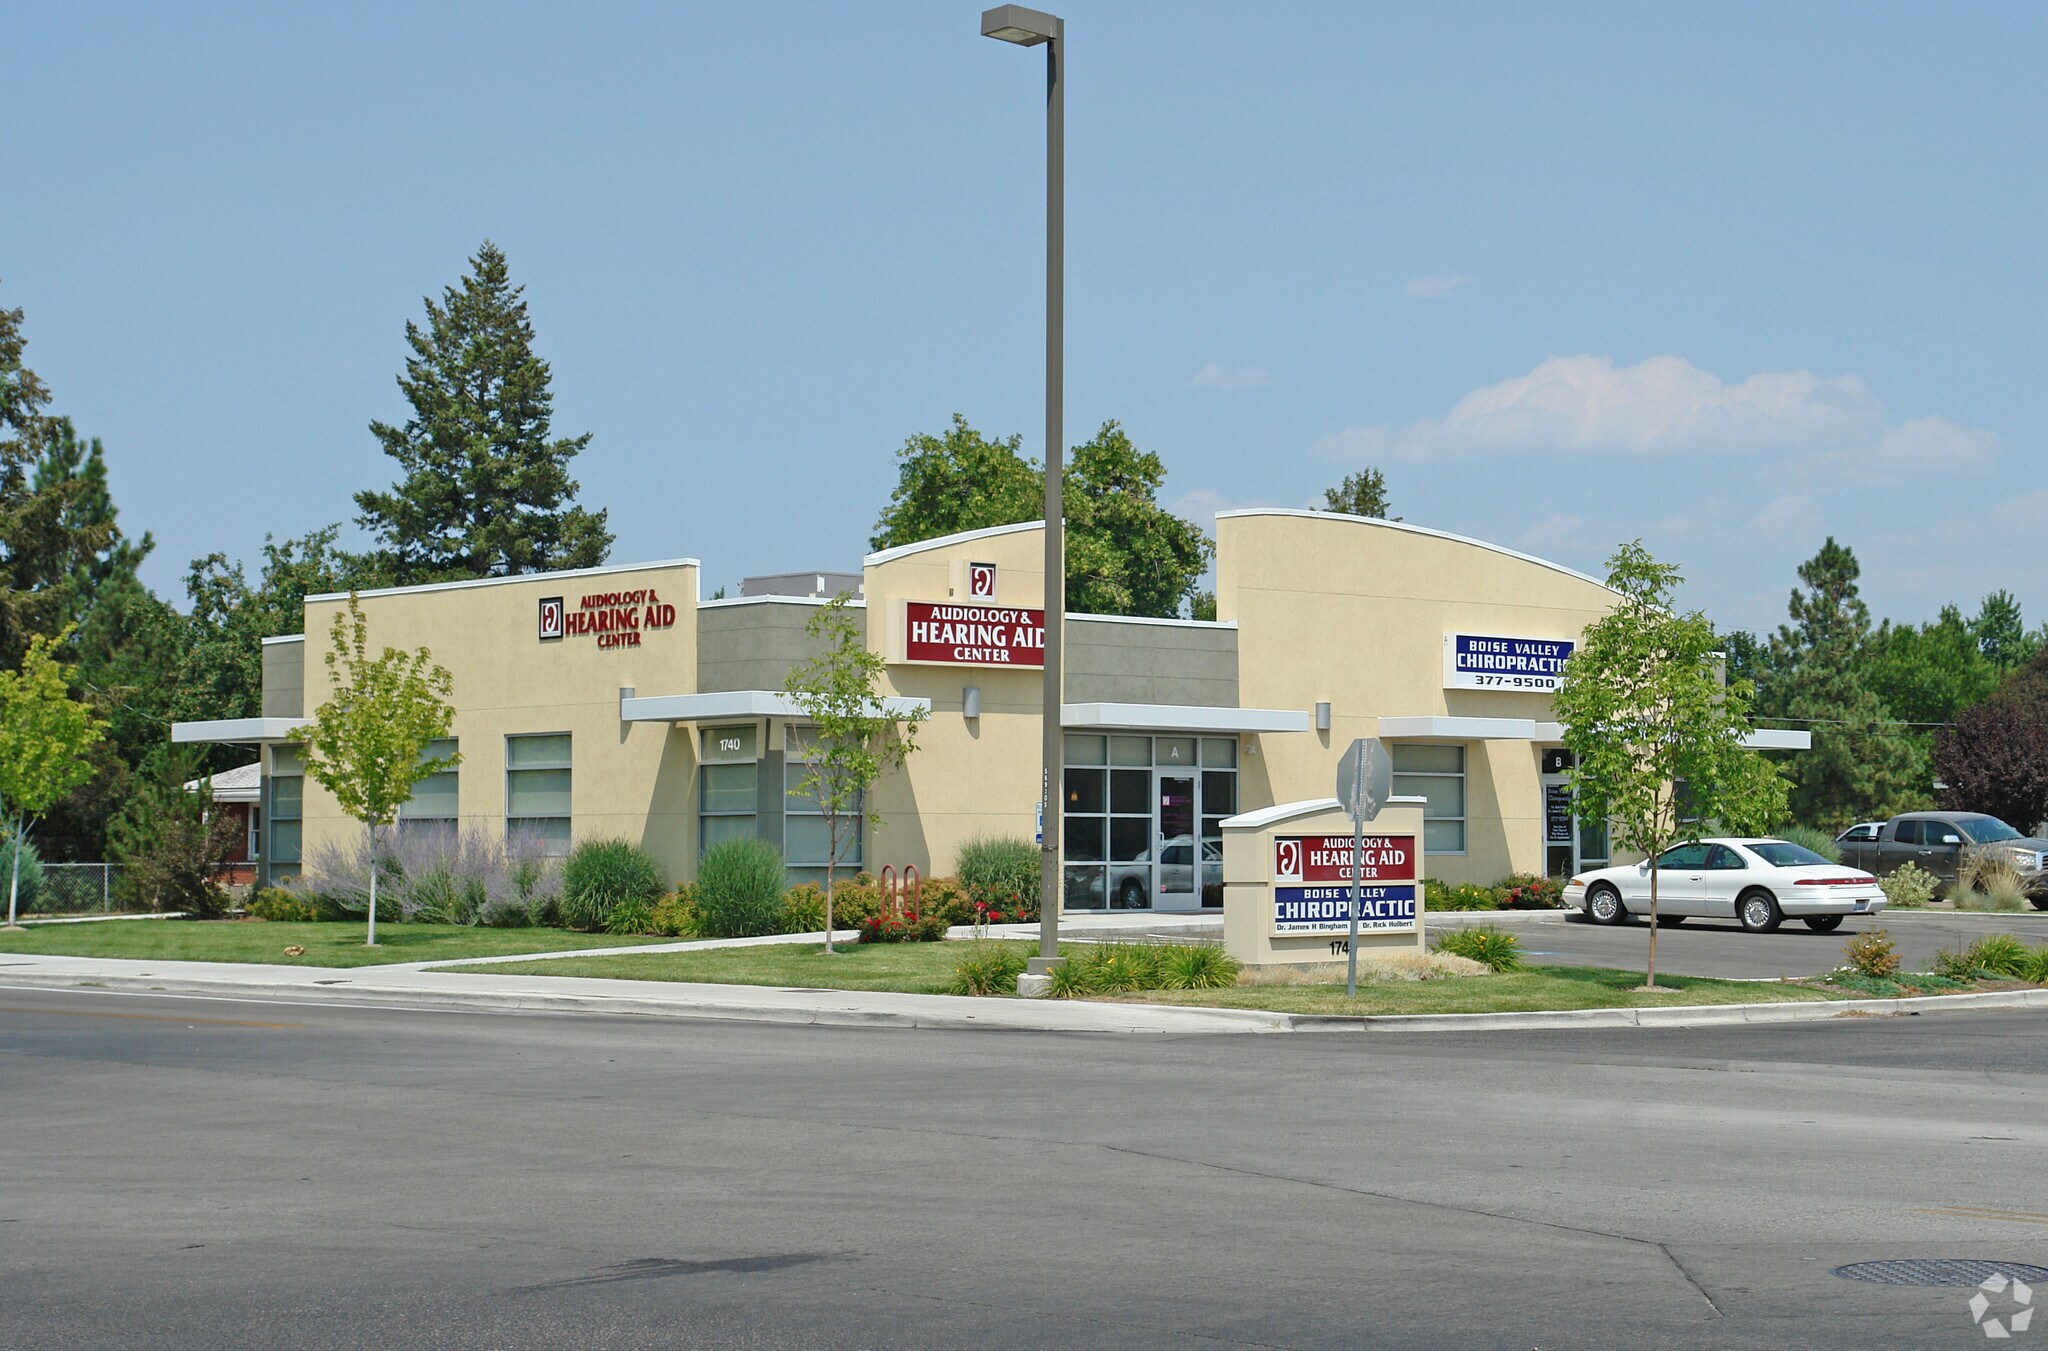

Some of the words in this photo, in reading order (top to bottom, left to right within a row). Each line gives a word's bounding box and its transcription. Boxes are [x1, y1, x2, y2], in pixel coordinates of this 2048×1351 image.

[581, 590, 647, 608] AUDIOLOGY
[649, 589, 659, 602] &
[565, 607, 639, 634] HEARING
[644, 605, 675, 628] AID
[930, 607, 1018, 624] AUDIOLOGY
[1020, 612, 1033, 624] &
[597, 632, 641, 648] CENTER
[912, 621, 1007, 647] HEARING
[953, 647, 1010, 662] CENTER
[1469, 640, 1508, 653] BOISE
[1515, 642, 1560, 656] VALLEY
[1475, 675, 1555, 688] 377-9500
[719, 738, 741, 751] 1740
[1171, 746, 1179, 758] A
[1555, 757, 1562, 767] B
[1322, 838, 1383, 849] AUDIOOGY
[1384, 837, 1393, 848] &
[1378, 850, 1405, 866] AID
[1339, 867, 1378, 878] CETER
[1304, 888, 1340, 899] BOISE
[1345, 887, 1386, 898] VLLEY
[1319, 922, 1348, 931] Bingham
[1373, 921, 1387, 929] Rick
[1329, 940, 1350, 956] 174
